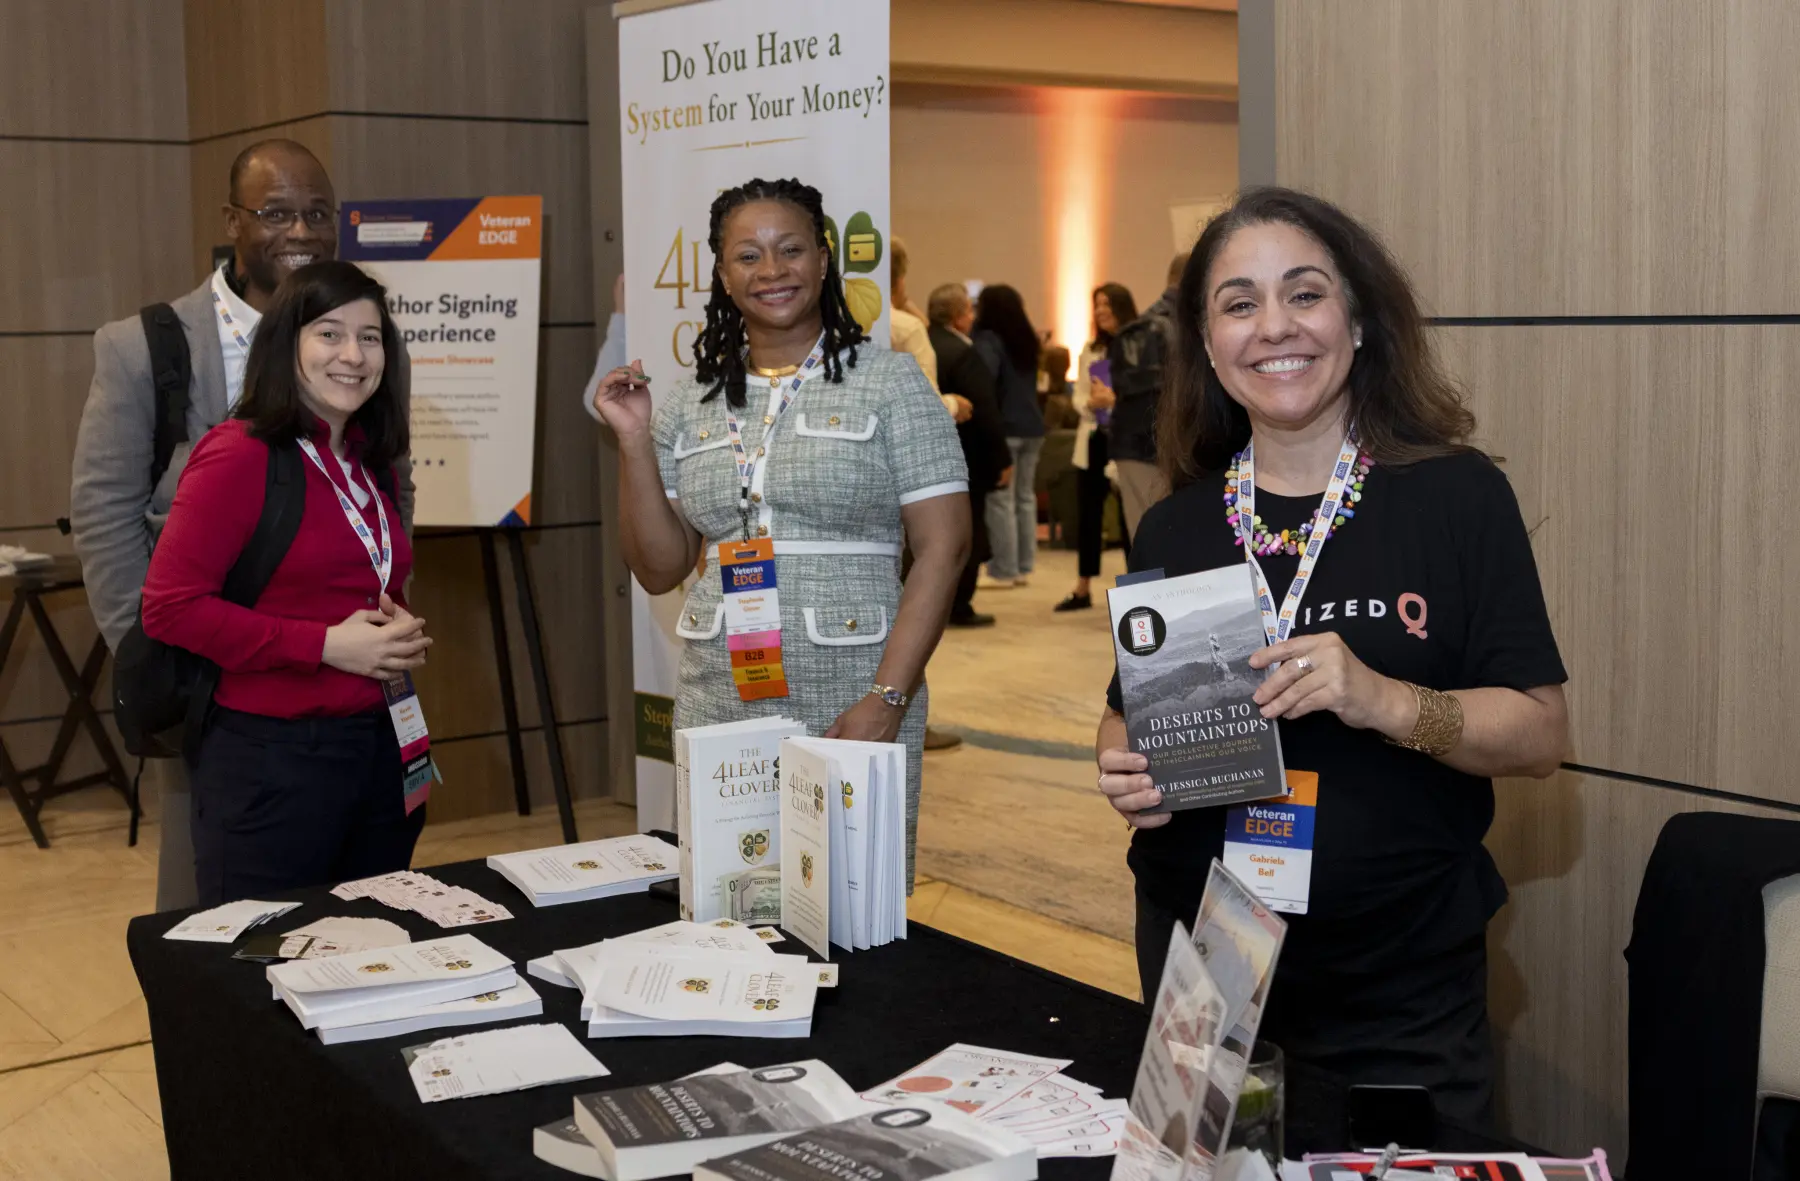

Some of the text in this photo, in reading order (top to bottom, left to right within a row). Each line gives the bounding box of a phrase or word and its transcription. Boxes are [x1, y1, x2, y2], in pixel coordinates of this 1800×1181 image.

[661, 31, 842, 83] Do You Have a
[627, 75, 885, 145] System for Your Money?
[480, 213, 531, 228] Veteran
[478, 230, 518, 245] EDGE
[388, 293, 518, 319] thor Signing
[403, 324, 496, 344] perience
[732, 565, 764, 577] Veteran
[733, 573, 764, 587] EDGE
[744, 650, 765, 661] B2B
[1150, 703, 1251, 732] DESERTS TO
[1137, 718, 1269, 751] MOUNTAINTOPS
[740, 748, 761, 758] THE
[1152, 737, 1258, 760] OUR COLLECTIVE JOURNEY
[1219, 748, 1235, 757] OUR
[1237, 744, 1262, 753] VOICE
[712, 760, 769, 783] 4LEAF
[1155, 783, 1167, 793] BY
[1169, 777, 1209, 793] JESSICA
[1211, 768, 1265, 785] BUCHANAN
[719, 779, 780, 798] CLOVER
[1247, 806, 1295, 821] Veteran
[1245, 818, 1293, 837] EDGE
[1249, 853, 1285, 865] Gabriela
[1258, 867, 1275, 877] Bell
